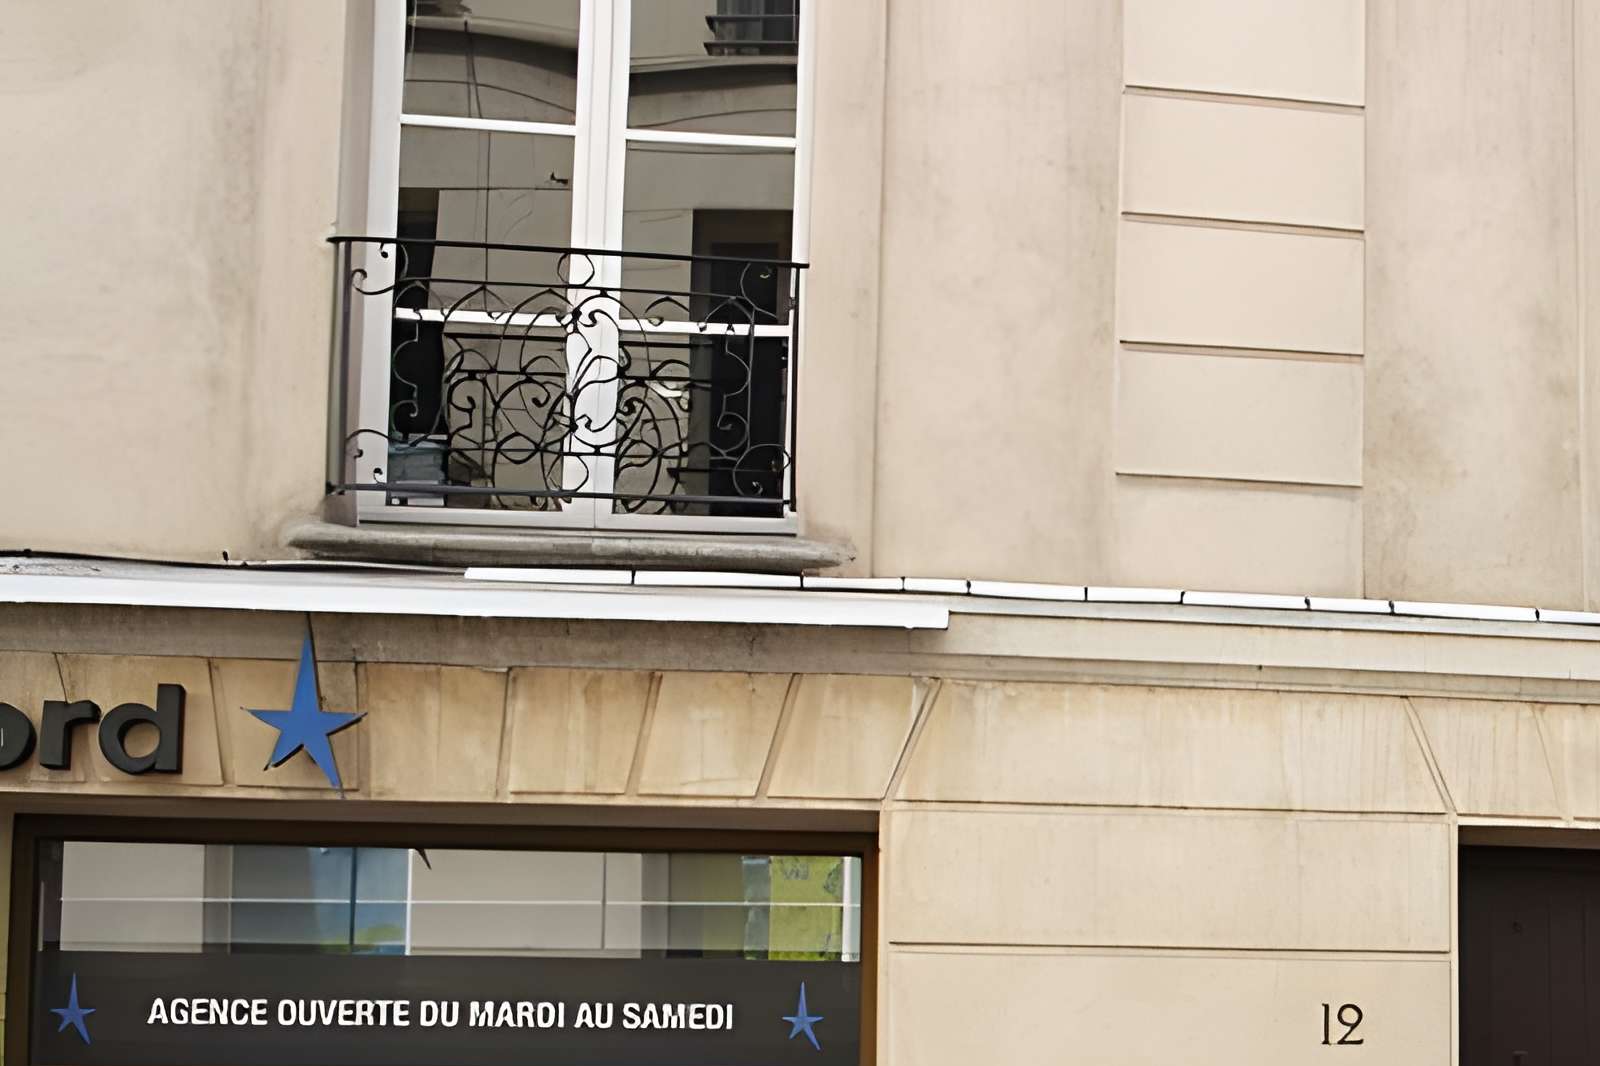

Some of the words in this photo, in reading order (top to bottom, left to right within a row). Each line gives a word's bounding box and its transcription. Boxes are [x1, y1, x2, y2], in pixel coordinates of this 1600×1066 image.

[146, 997, 268, 1026] AGENCE
[277, 999, 410, 1027] OUVERTE
[419, 1000, 460, 1028] DU
[468, 1000, 565, 1028] MARDI
[573, 1002, 614, 1029] AU
[622, 1002, 733, 1030] SAMEDI
[1321, 1002, 1364, 1046] 12
